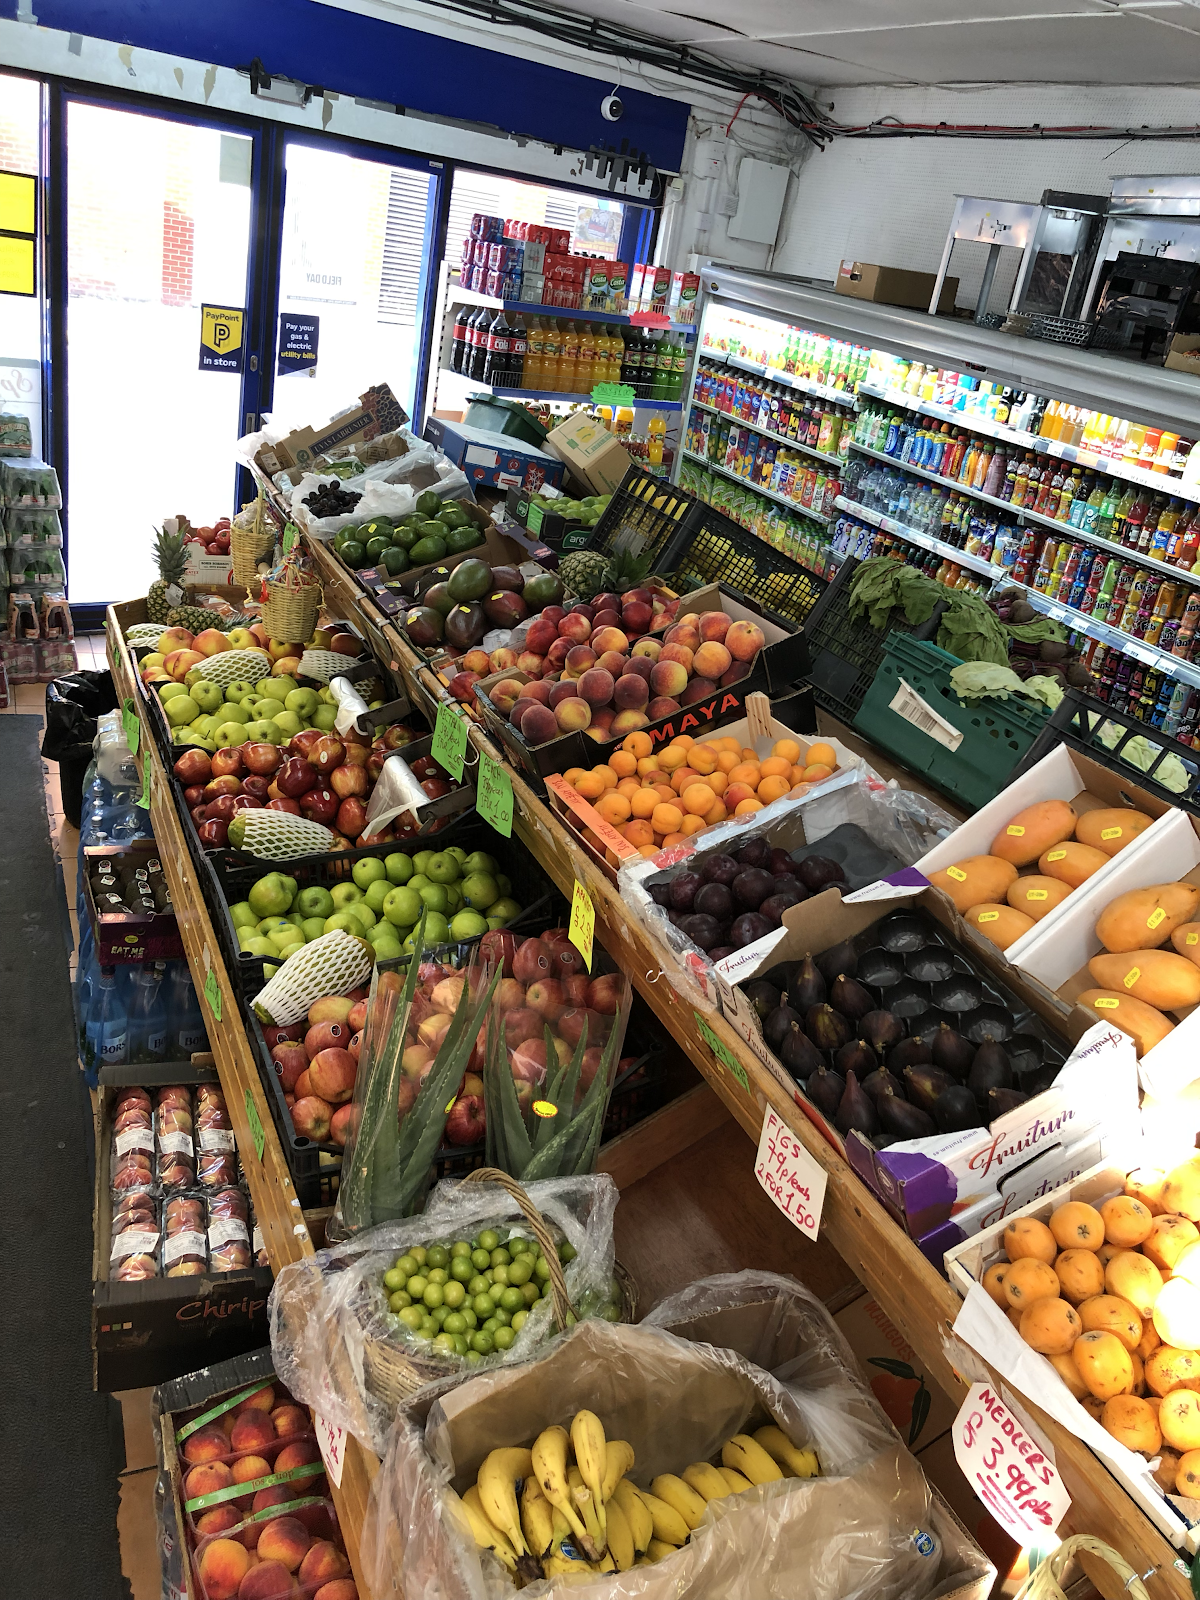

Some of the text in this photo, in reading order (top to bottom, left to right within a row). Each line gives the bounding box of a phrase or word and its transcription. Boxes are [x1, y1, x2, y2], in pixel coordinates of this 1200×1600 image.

[205, 311, 240, 322] PayPoint
[286, 322, 298, 331] Pay
[287, 342, 312, 350] electric
[290, 333, 303, 341] gas
[203, 356, 238, 367] in store
[281, 351, 316, 360] utility bills
[313, 436, 335, 454] UVAS
[650, 693, 740, 745] MAYA
[111, 946, 145, 955] EAT ME
[718, 949, 761, 975] Fruitum
[1077, 1031, 1123, 1061] Fruitum
[766, 1114, 801, 1159] FIGS
[968, 1108, 1076, 1180] Fruitum
[757, 1163, 816, 1230] 2 FOR 1.50
[978, 1388, 1055, 1486] MEDLERS
[251, 1469, 294, 1491] don sol
